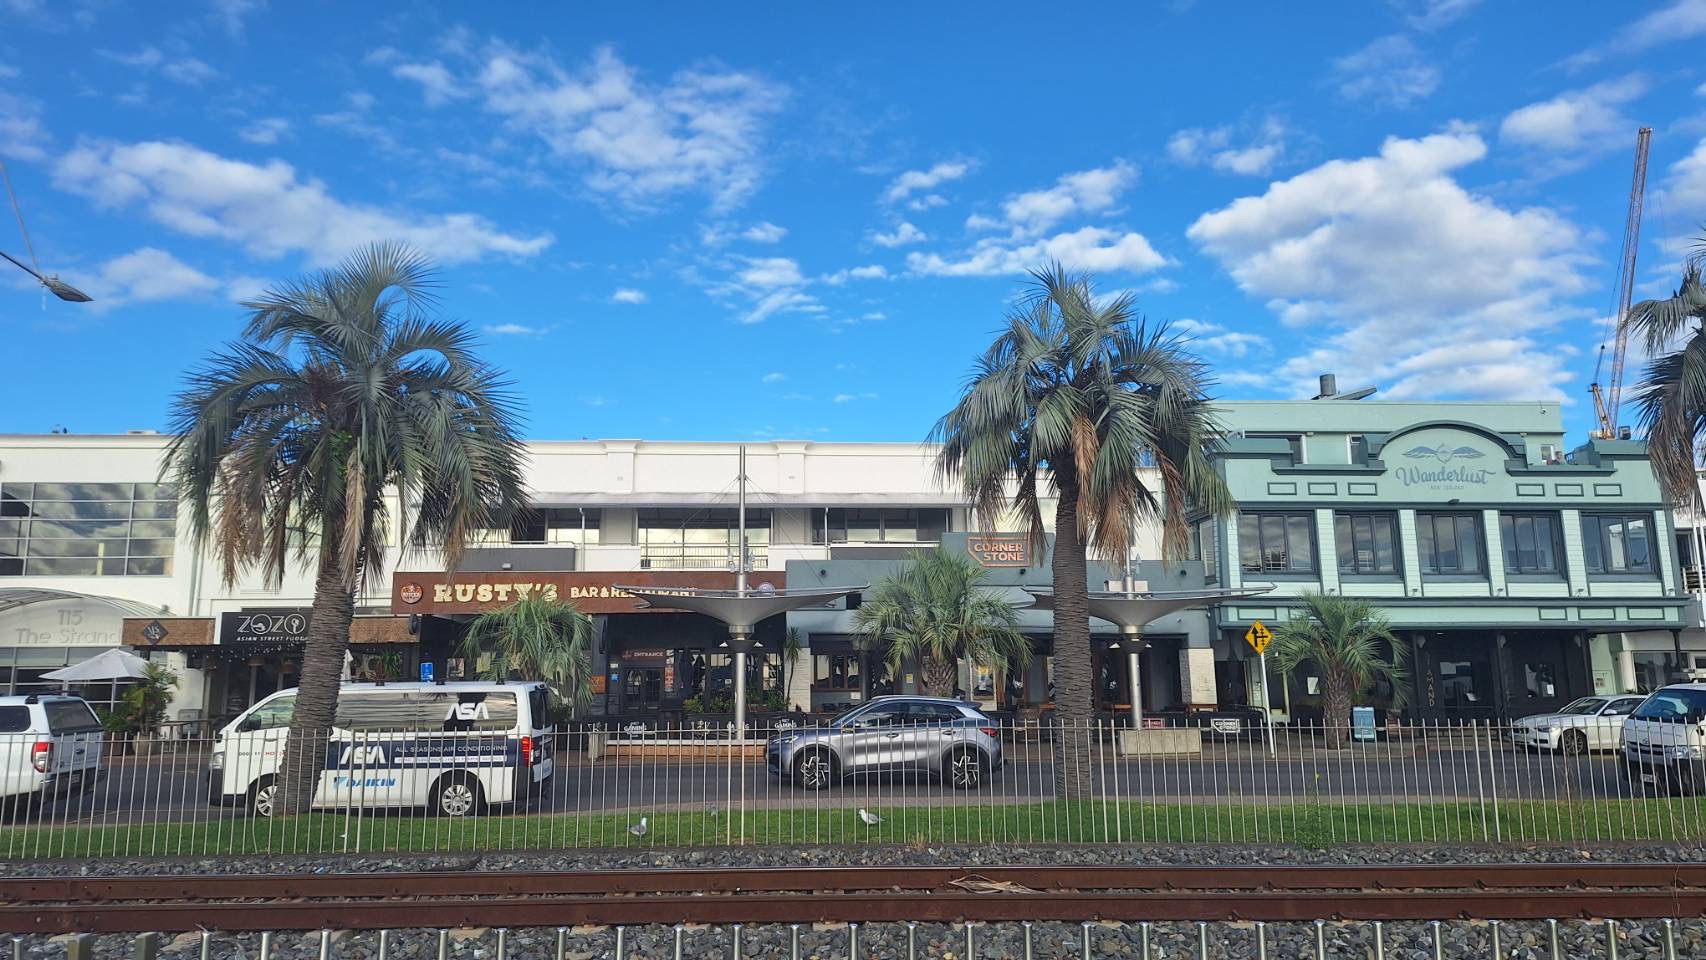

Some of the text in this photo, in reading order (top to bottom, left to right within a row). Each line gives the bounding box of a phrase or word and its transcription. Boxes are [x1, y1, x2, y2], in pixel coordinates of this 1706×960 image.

[1395, 465, 1496, 486] Wanderlust
[973, 543, 1024, 552] CORNER
[984, 552, 1024, 561] STONE
[433, 583, 558, 602] RUSTY'S
[57, 609, 84, 626] 115
[237, 613, 306, 635] ZOZO
[15, 628, 51, 644] The
[444, 702, 490, 720] ASA
[339, 745, 387, 764] ASA
[346, 778, 396, 787] DAIKIN
